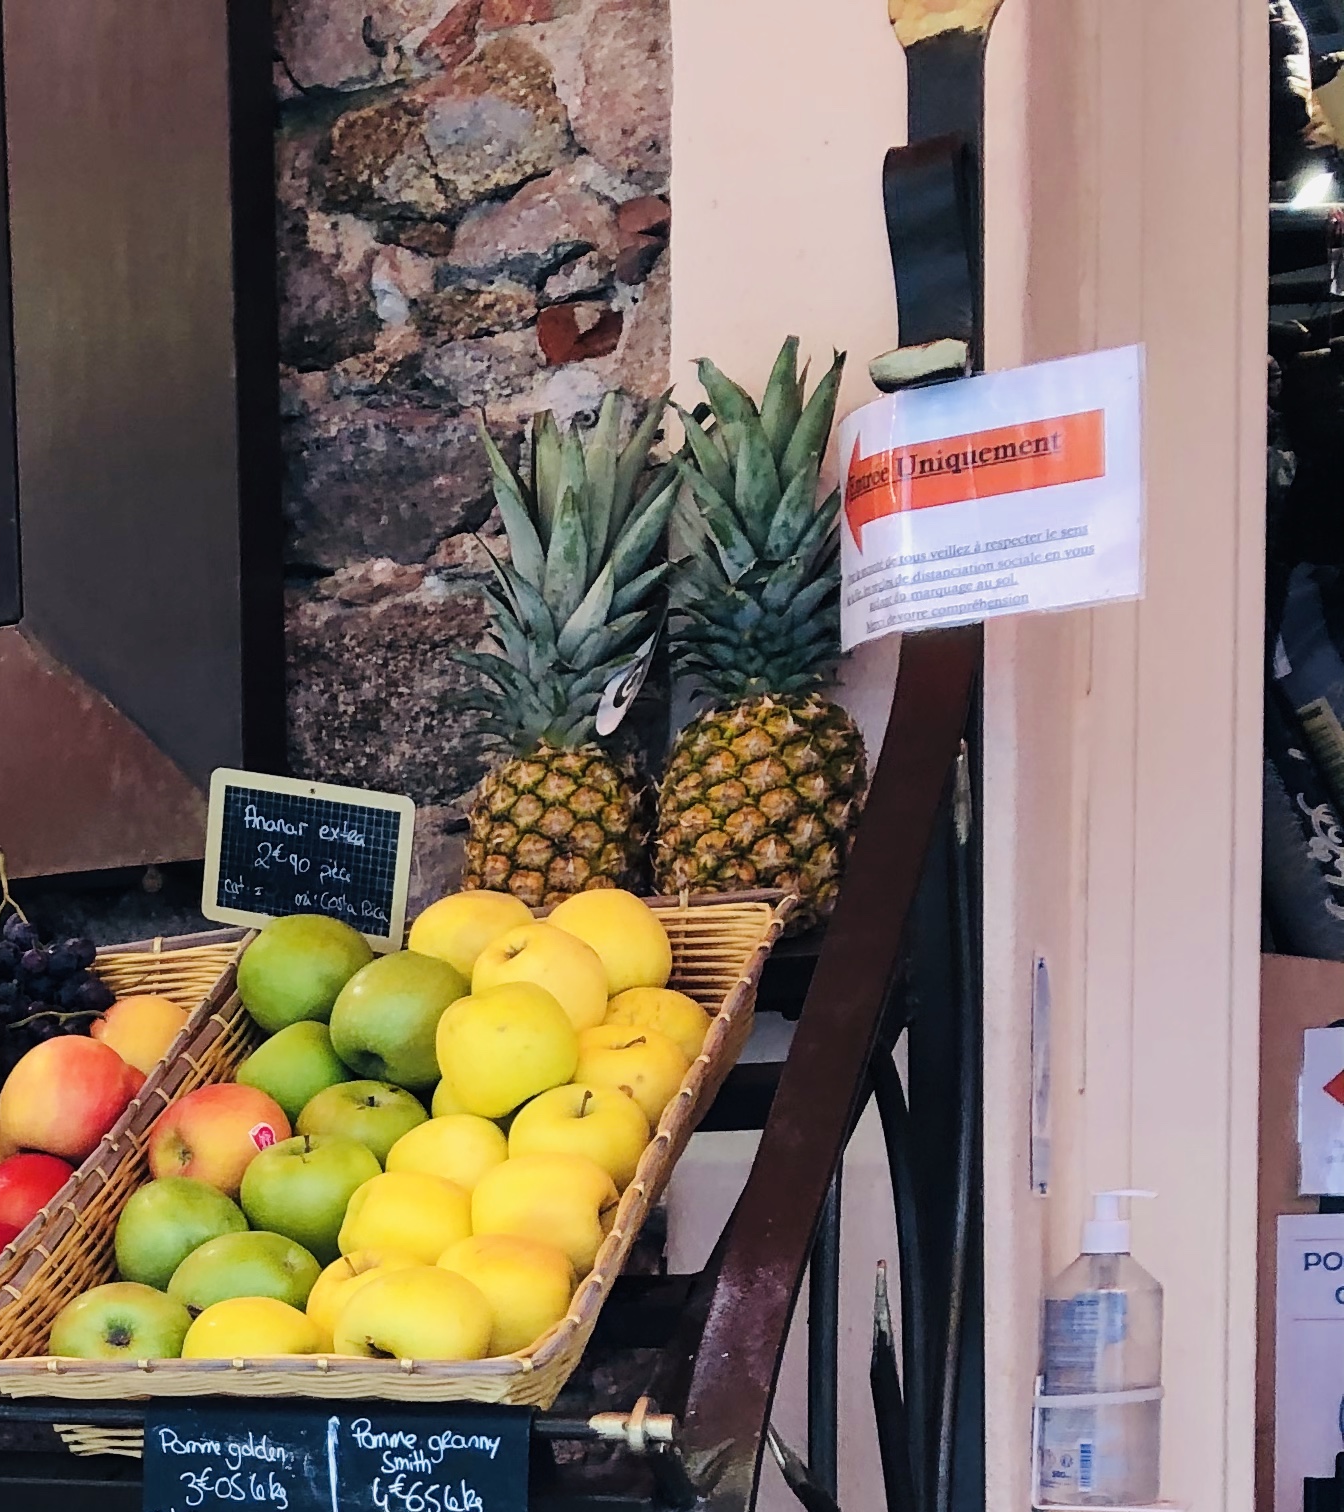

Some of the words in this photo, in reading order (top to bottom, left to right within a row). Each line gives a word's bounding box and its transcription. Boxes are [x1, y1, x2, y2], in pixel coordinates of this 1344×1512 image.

[896, 431, 1062, 478] Uniquement
[930, 545, 972, 560] veillez
[985, 532, 1042, 551] respecter
[1045, 528, 1057, 541] le
[1060, 523, 1088, 538] sens
[912, 561, 994, 583] distanciation
[998, 552, 1040, 569] sociale
[1045, 549, 1061, 561] en
[1065, 543, 1095, 557] vous
[912, 580, 972, 602] marquage
[976, 579, 992, 591] au
[931, 593, 1029, 617] compréhension
[255, 842, 310, 875] 2€90
[158, 1427, 221, 1456] Pomme
[228, 1435, 286, 1470] golden
[350, 1417, 417, 1451] Pomme
[381, 1448, 432, 1475] Smith
[180, 1467, 248, 1506] 3€05
